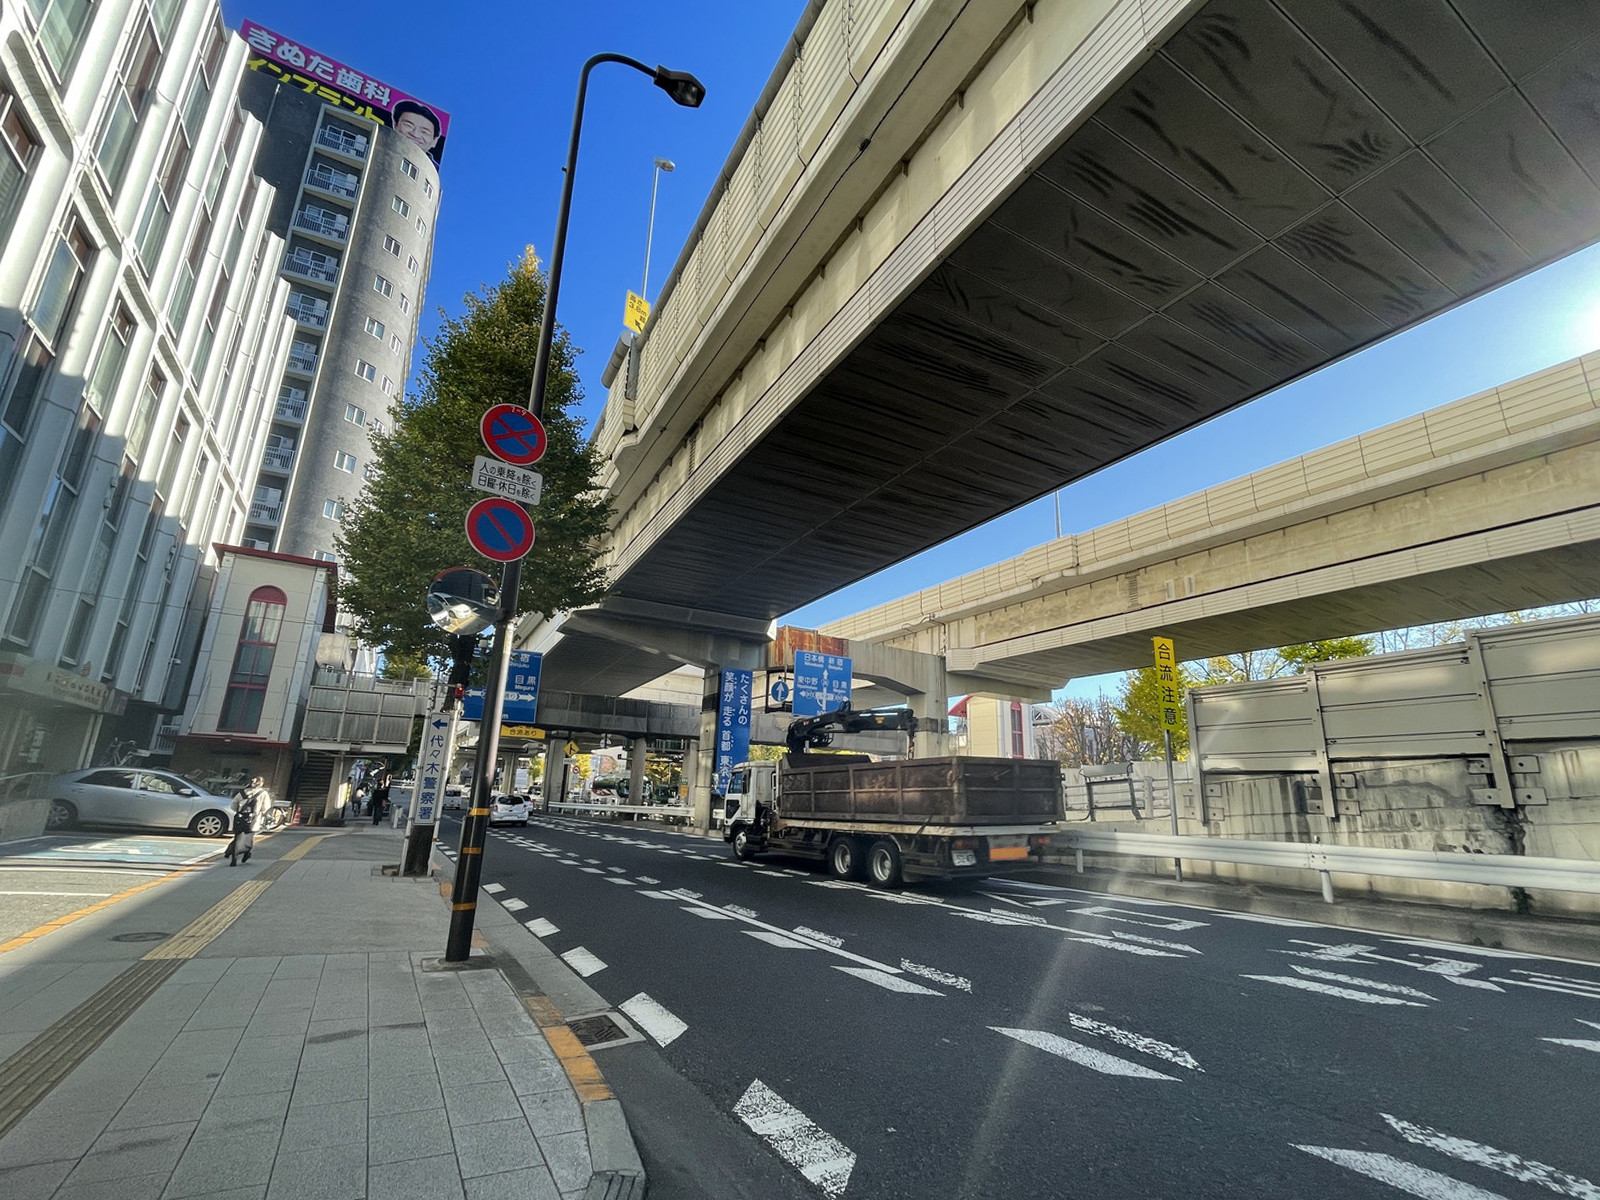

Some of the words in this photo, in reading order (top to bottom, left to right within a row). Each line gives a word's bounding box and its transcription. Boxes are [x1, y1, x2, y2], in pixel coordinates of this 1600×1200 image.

[247, 27, 392, 107] きぬた歯科
[247, 58, 385, 126] インプラント
[479, 461, 536, 487] 人の乗降を除く
[515, 675, 536, 686] 目黒
[724, 671, 735, 702] 笑顔が
[738, 673, 750, 725] たくさんの
[1158, 643, 1177, 725] 合流注意
[722, 705, 733, 727] 走る
[721, 730, 731, 751] 首都
[418, 735, 444, 820] 代々木警察署
